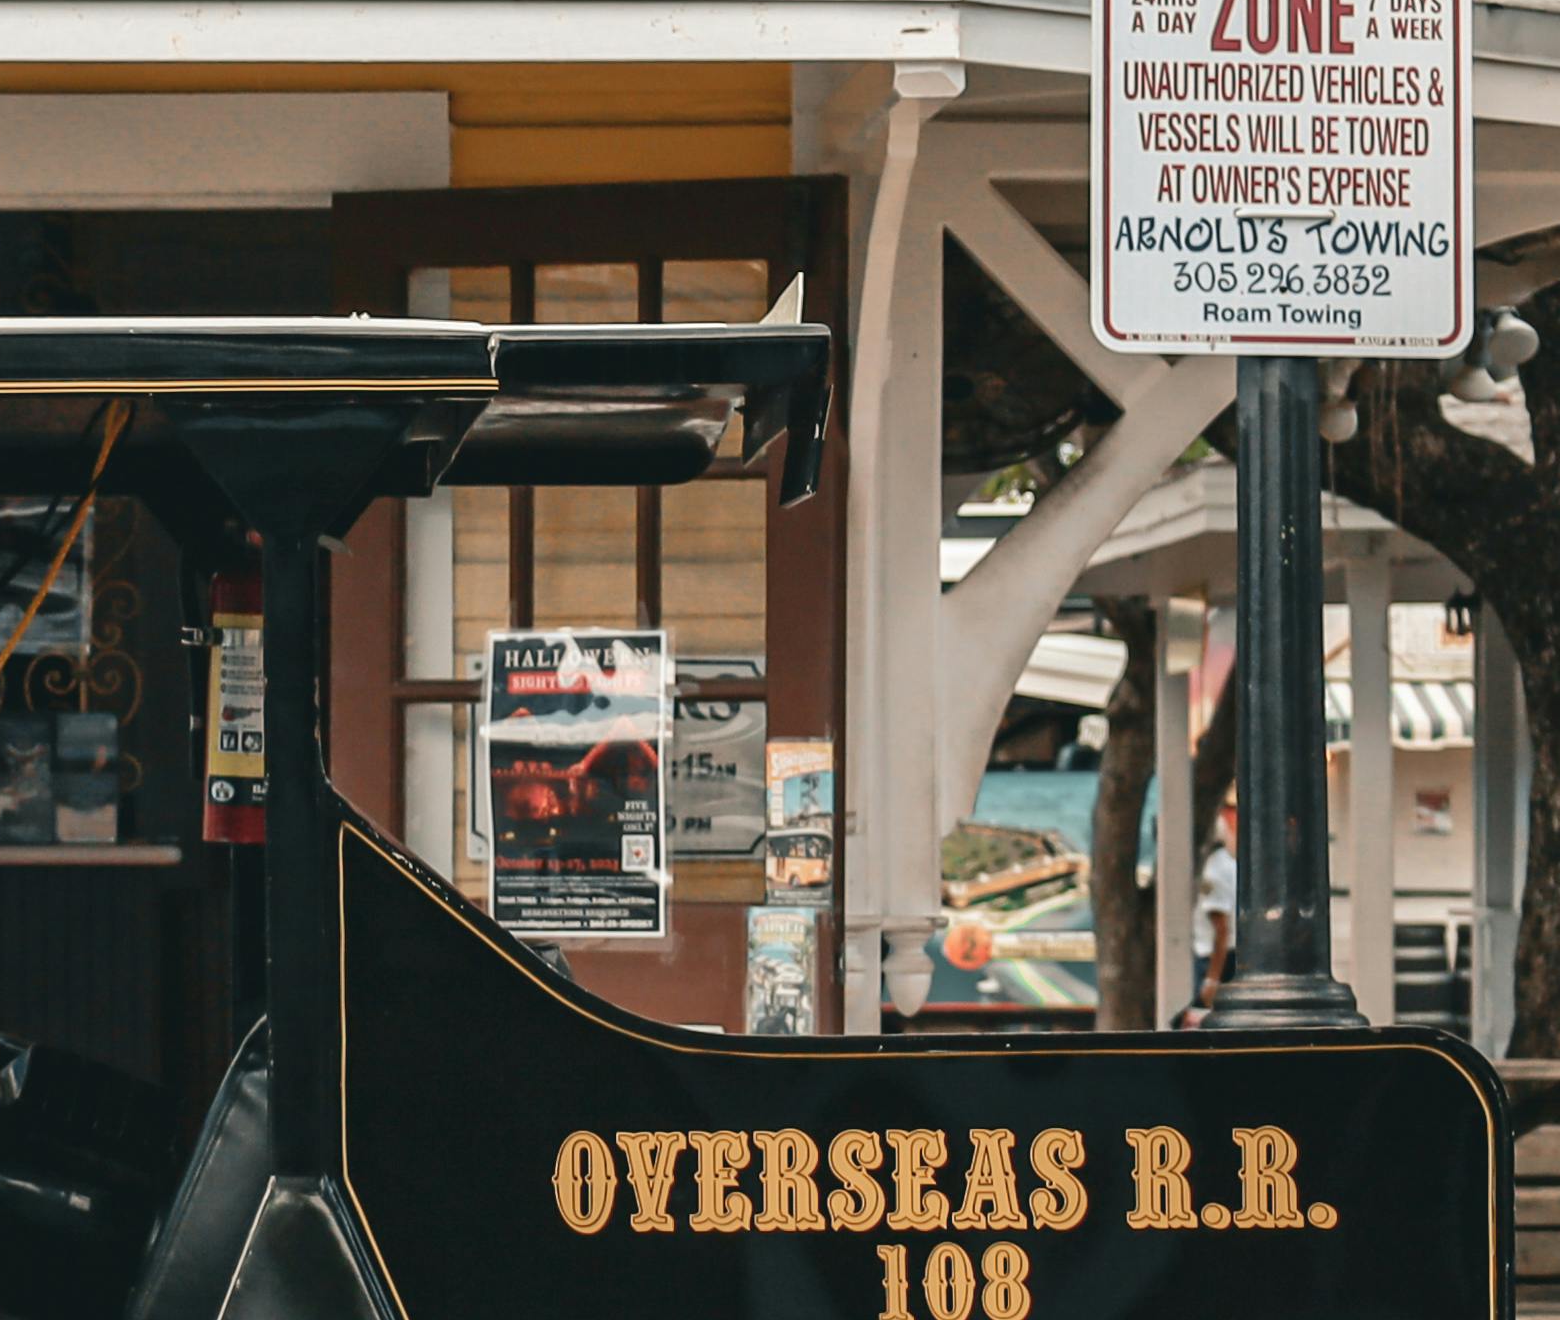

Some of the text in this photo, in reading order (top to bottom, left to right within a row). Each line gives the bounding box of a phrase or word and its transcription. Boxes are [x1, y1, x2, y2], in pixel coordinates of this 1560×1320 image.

[1132, 11, 1198, 34] A DAY
[1366, 17, 1444, 41] A WEEK
[1123, 61, 1445, 107] UNAUTHORIZED VEHICLES &
[1138, 112, 1429, 157] VESSELS WILL BE TOWED
[1157, 164, 1410, 208] AT OWNER'S EXPENSE
[1115, 215, 1450, 257] ARNOLD'S TOWING
[1173, 260, 1392, 298] 305.296.3832
[1203, 303, 1362, 329] Roam Towing
[552, 1125, 1338, 1234] OVERSEAS R.R.
